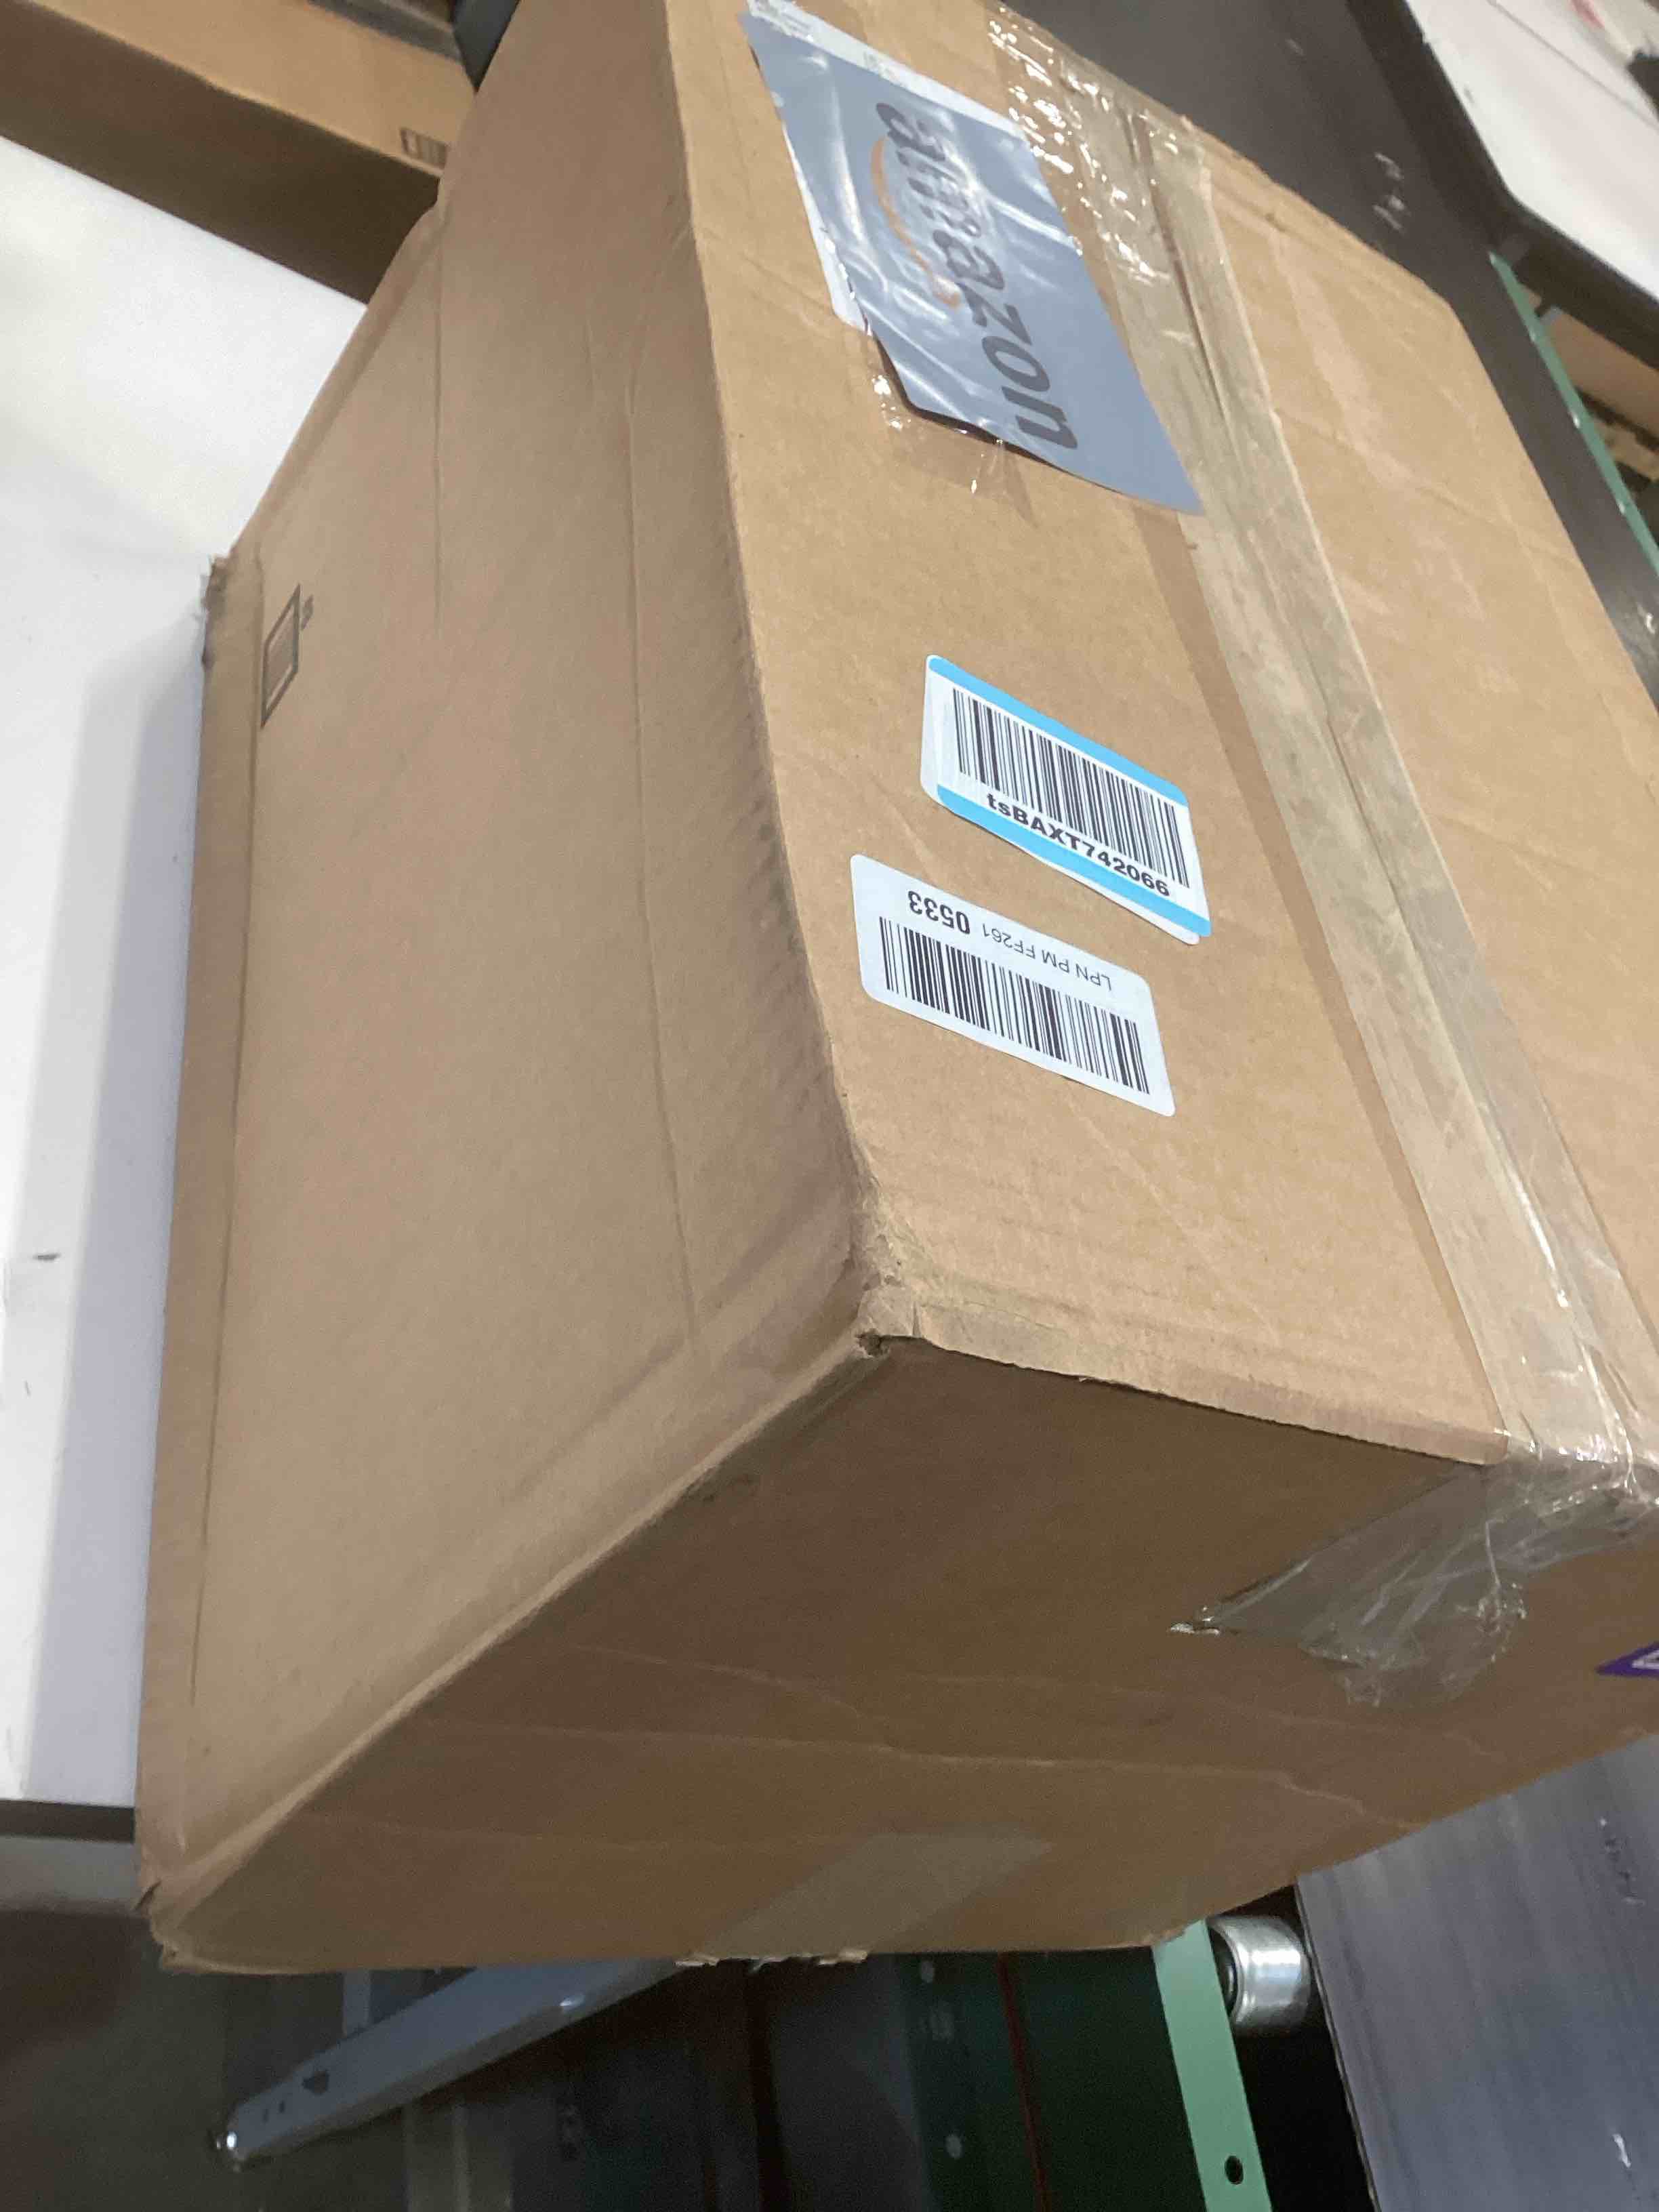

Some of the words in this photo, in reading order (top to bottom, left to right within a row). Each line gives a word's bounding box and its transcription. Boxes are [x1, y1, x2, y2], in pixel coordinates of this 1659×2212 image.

[987, 792, 1170, 897] tsBAXT742066
[907, 890, 970, 935] 0533
[983, 923, 1036, 960] FF261
[1042, 949, 1070, 973] PM
[1076, 963, 1112, 991] LPN
